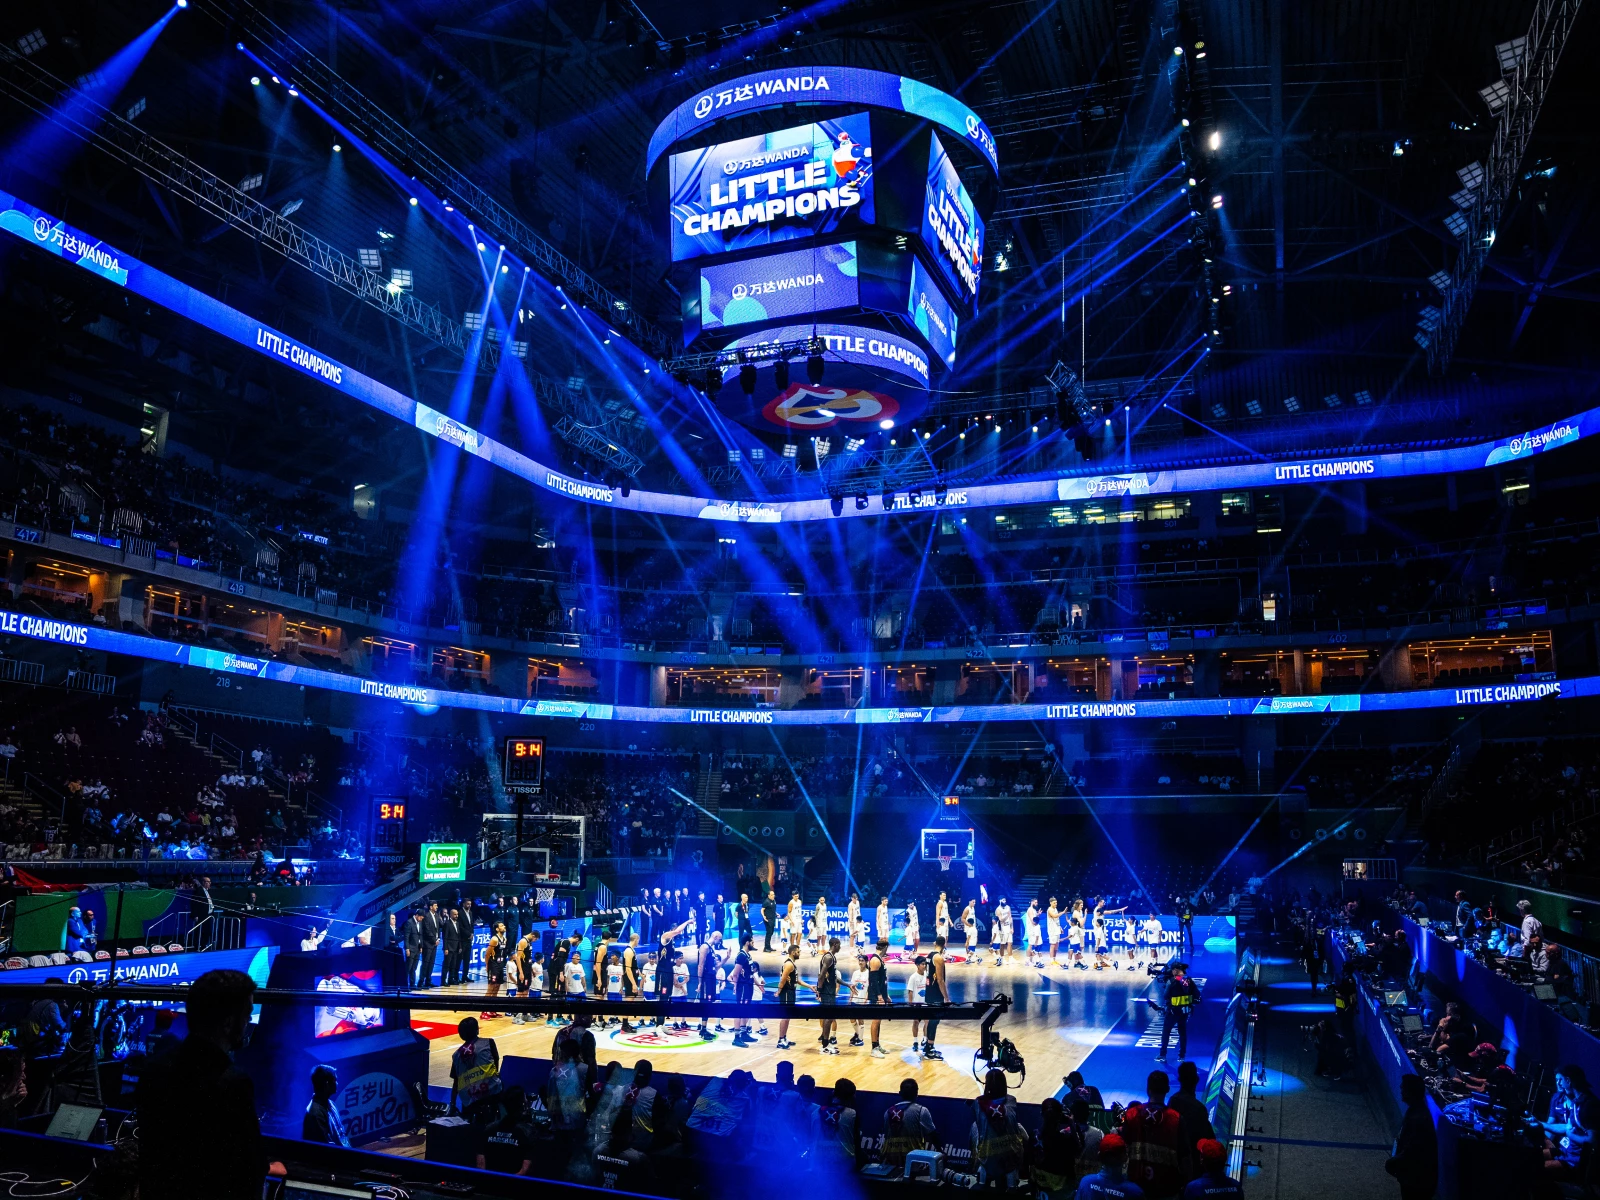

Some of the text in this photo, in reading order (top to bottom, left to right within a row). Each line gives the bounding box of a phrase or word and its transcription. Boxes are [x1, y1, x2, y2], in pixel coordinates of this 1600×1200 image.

[710, 160, 827, 207] LITTLE
[683, 183, 861, 236] CHAMPIONS
[938, 189, 973, 259] LITTLE
[928, 203, 977, 295] CHAMPIONS
[256, 328, 343, 384] LITTLE CHAMPIONS
[1275, 460, 1374, 480] LITTLE CHAMPIONS
[546, 472, 613, 502] LITTLE CHAMPIONS
[17, 528, 37, 542] 417
[229, 582, 245, 594] 418
[20, 615, 88, 645] CHAMPIONS
[217, 676, 231, 688] 218
[360, 680, 427, 702] LITTLE CHAMPIONS
[1455, 682, 1561, 704] LITTLE CHAMPIONS
[690, 709, 773, 723] LITTLE CHAMPIONS
[1046, 703, 1136, 718] LITTLE CHAMPIONS
[579, 722, 595, 732] 220
[515, 743, 541, 757] 9:14
[513, 786, 542, 794] TISSOT
[380, 803, 404, 819] 9:14
[379, 855, 405, 863] TISSOT
[437, 853, 459, 865] Smart
[345, 1078, 394, 1109] 百岁山
